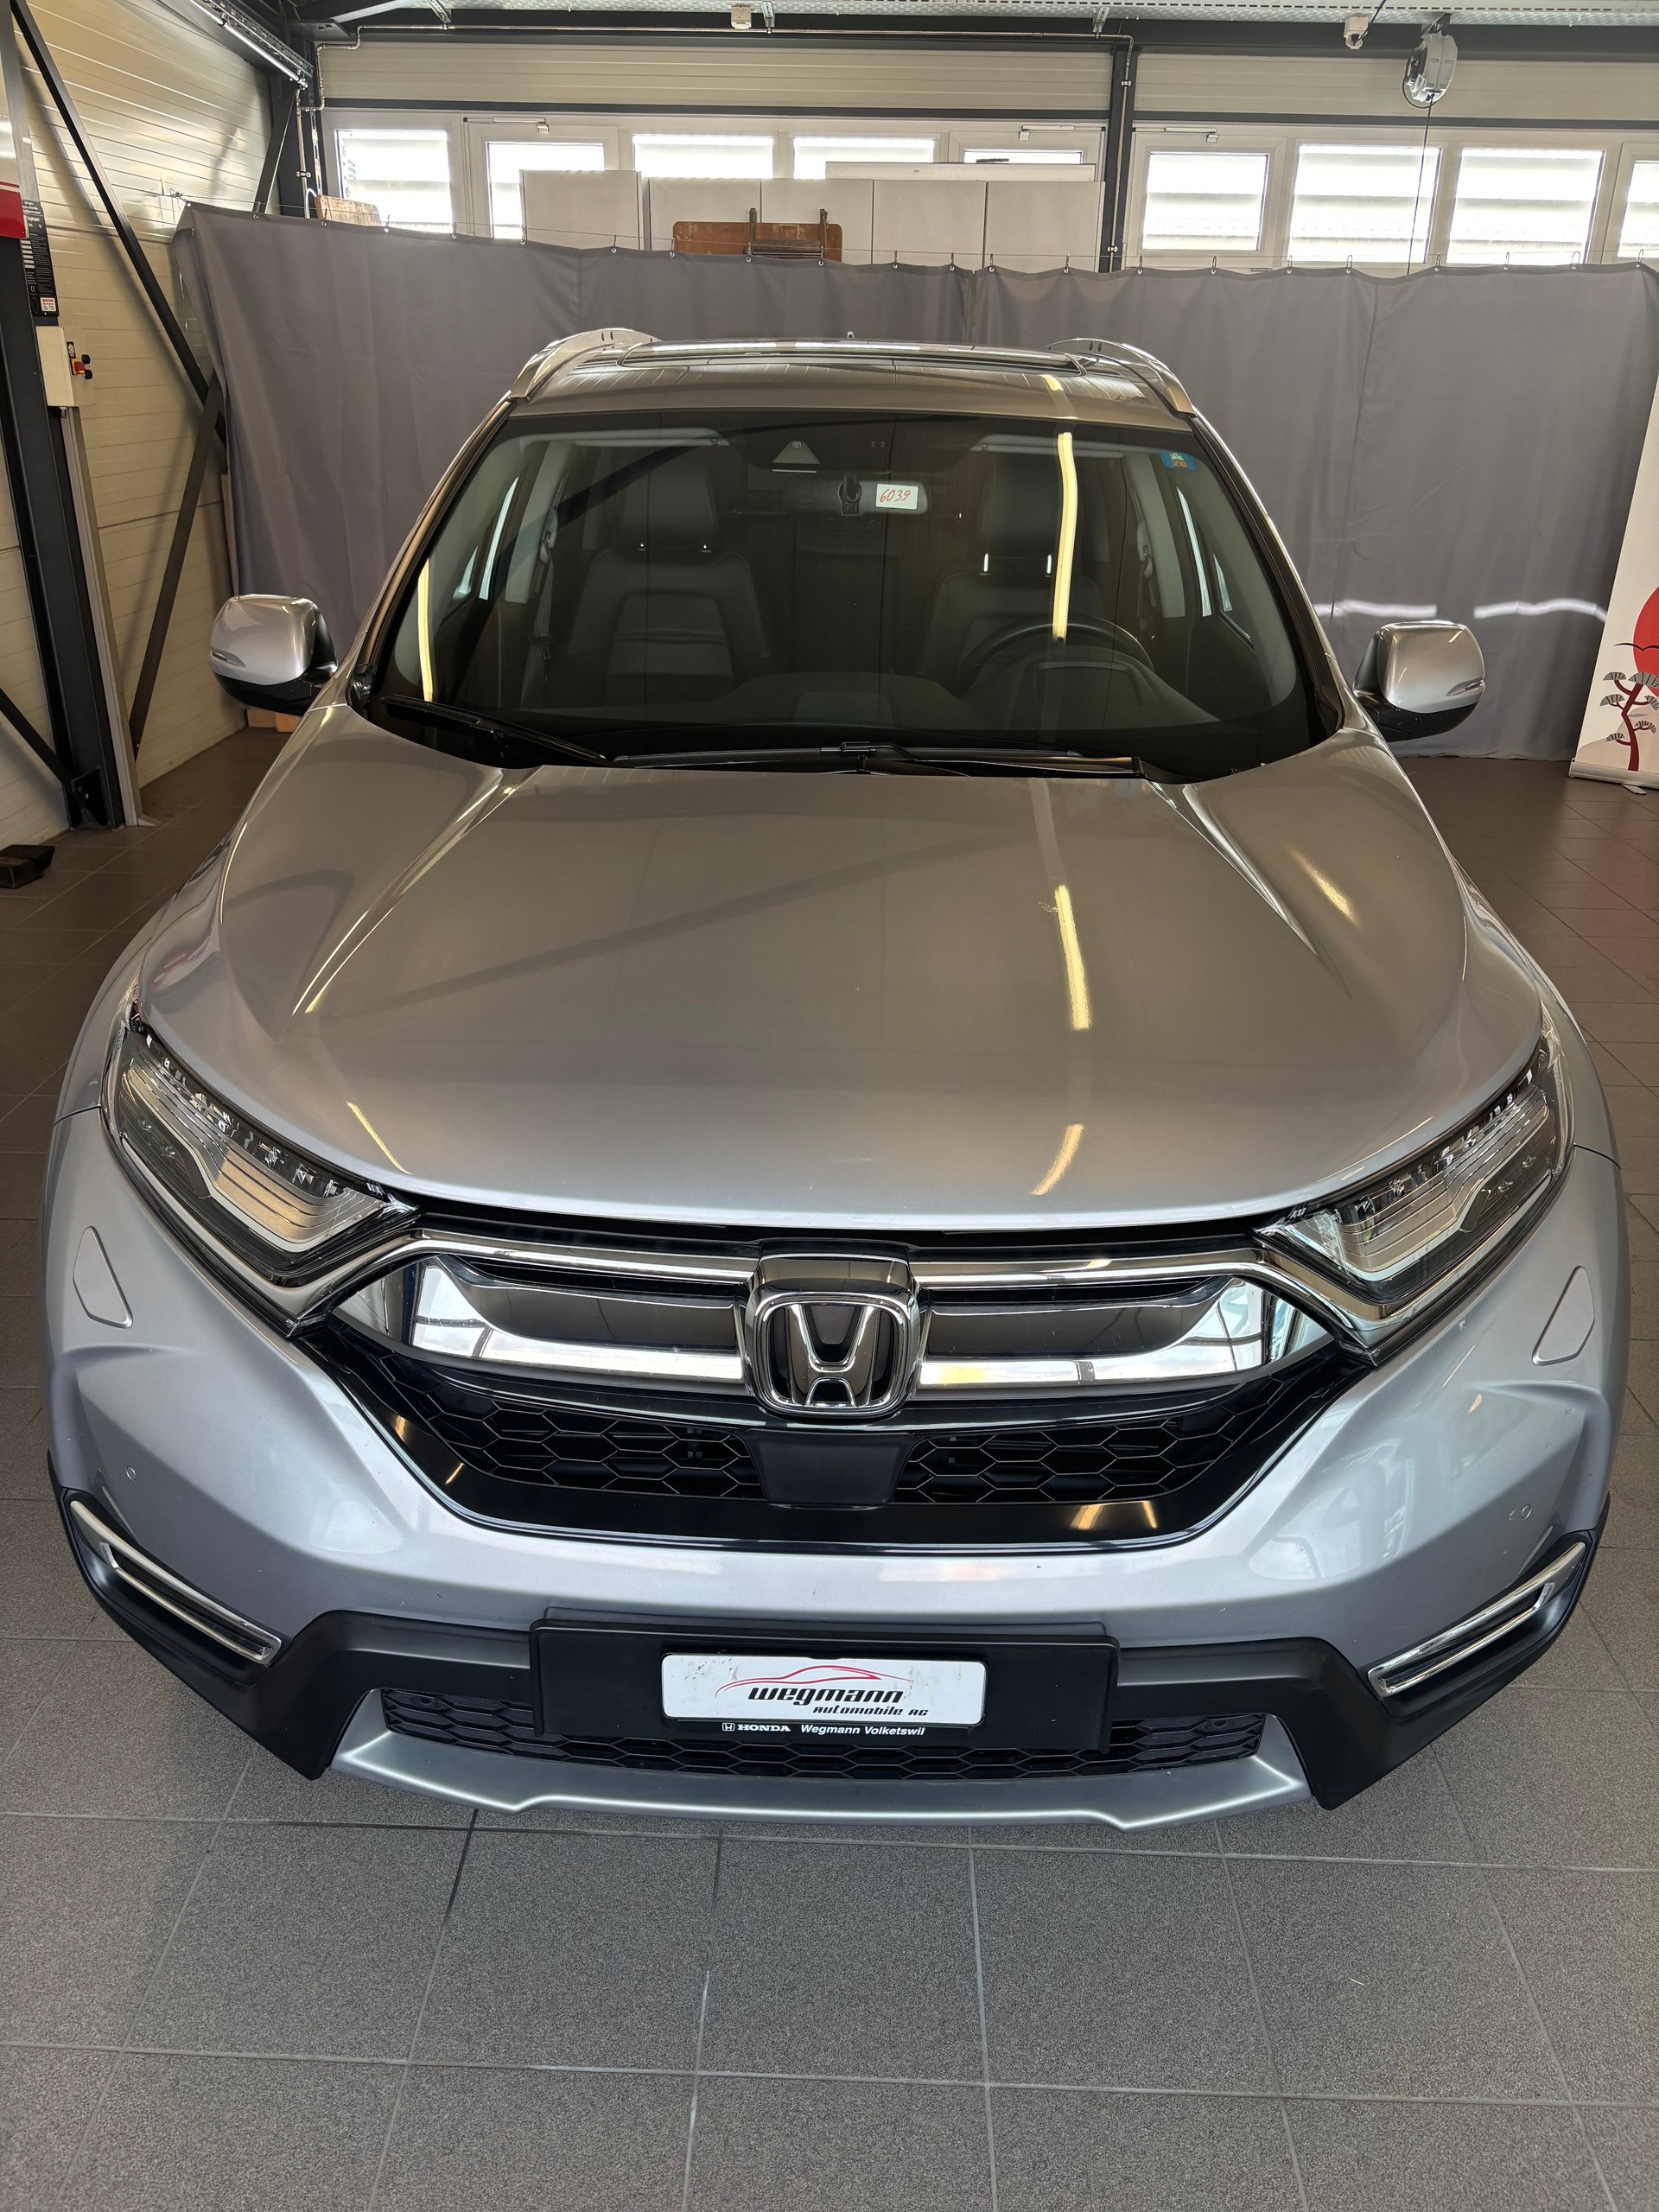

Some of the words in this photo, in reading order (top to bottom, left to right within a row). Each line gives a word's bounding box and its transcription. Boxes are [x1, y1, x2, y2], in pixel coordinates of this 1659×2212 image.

[880, 488, 912, 503] 6039
[747, 1688, 904, 1706] wegmann
[812, 1705, 904, 1716] automobile
[801, 1724, 861, 1736] Wegmann
[864, 1726, 925, 1736] Volketswil
